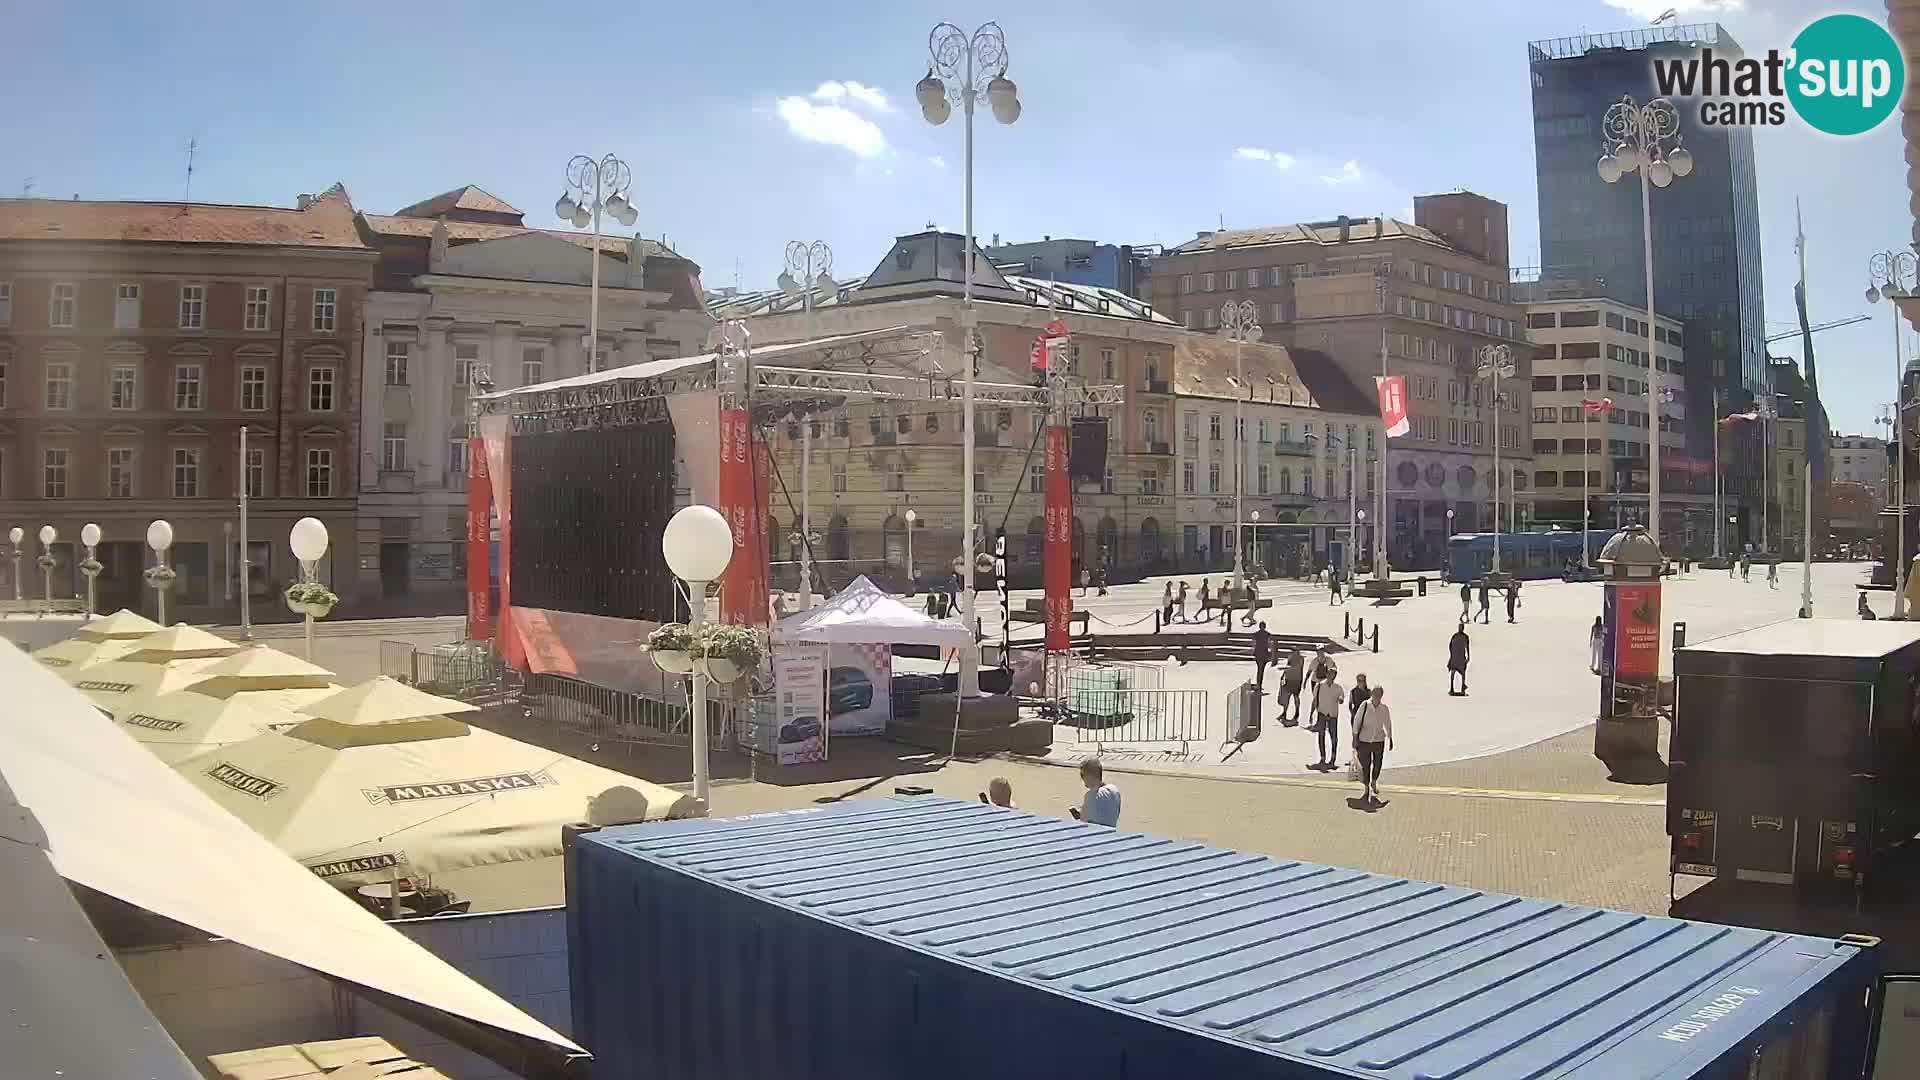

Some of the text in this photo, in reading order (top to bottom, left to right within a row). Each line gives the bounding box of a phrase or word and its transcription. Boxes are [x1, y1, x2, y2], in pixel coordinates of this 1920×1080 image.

[214, 765, 272, 796] MARASKA
[394, 774, 530, 801] MARASKA
[312, 854, 392, 878] MARASKA
